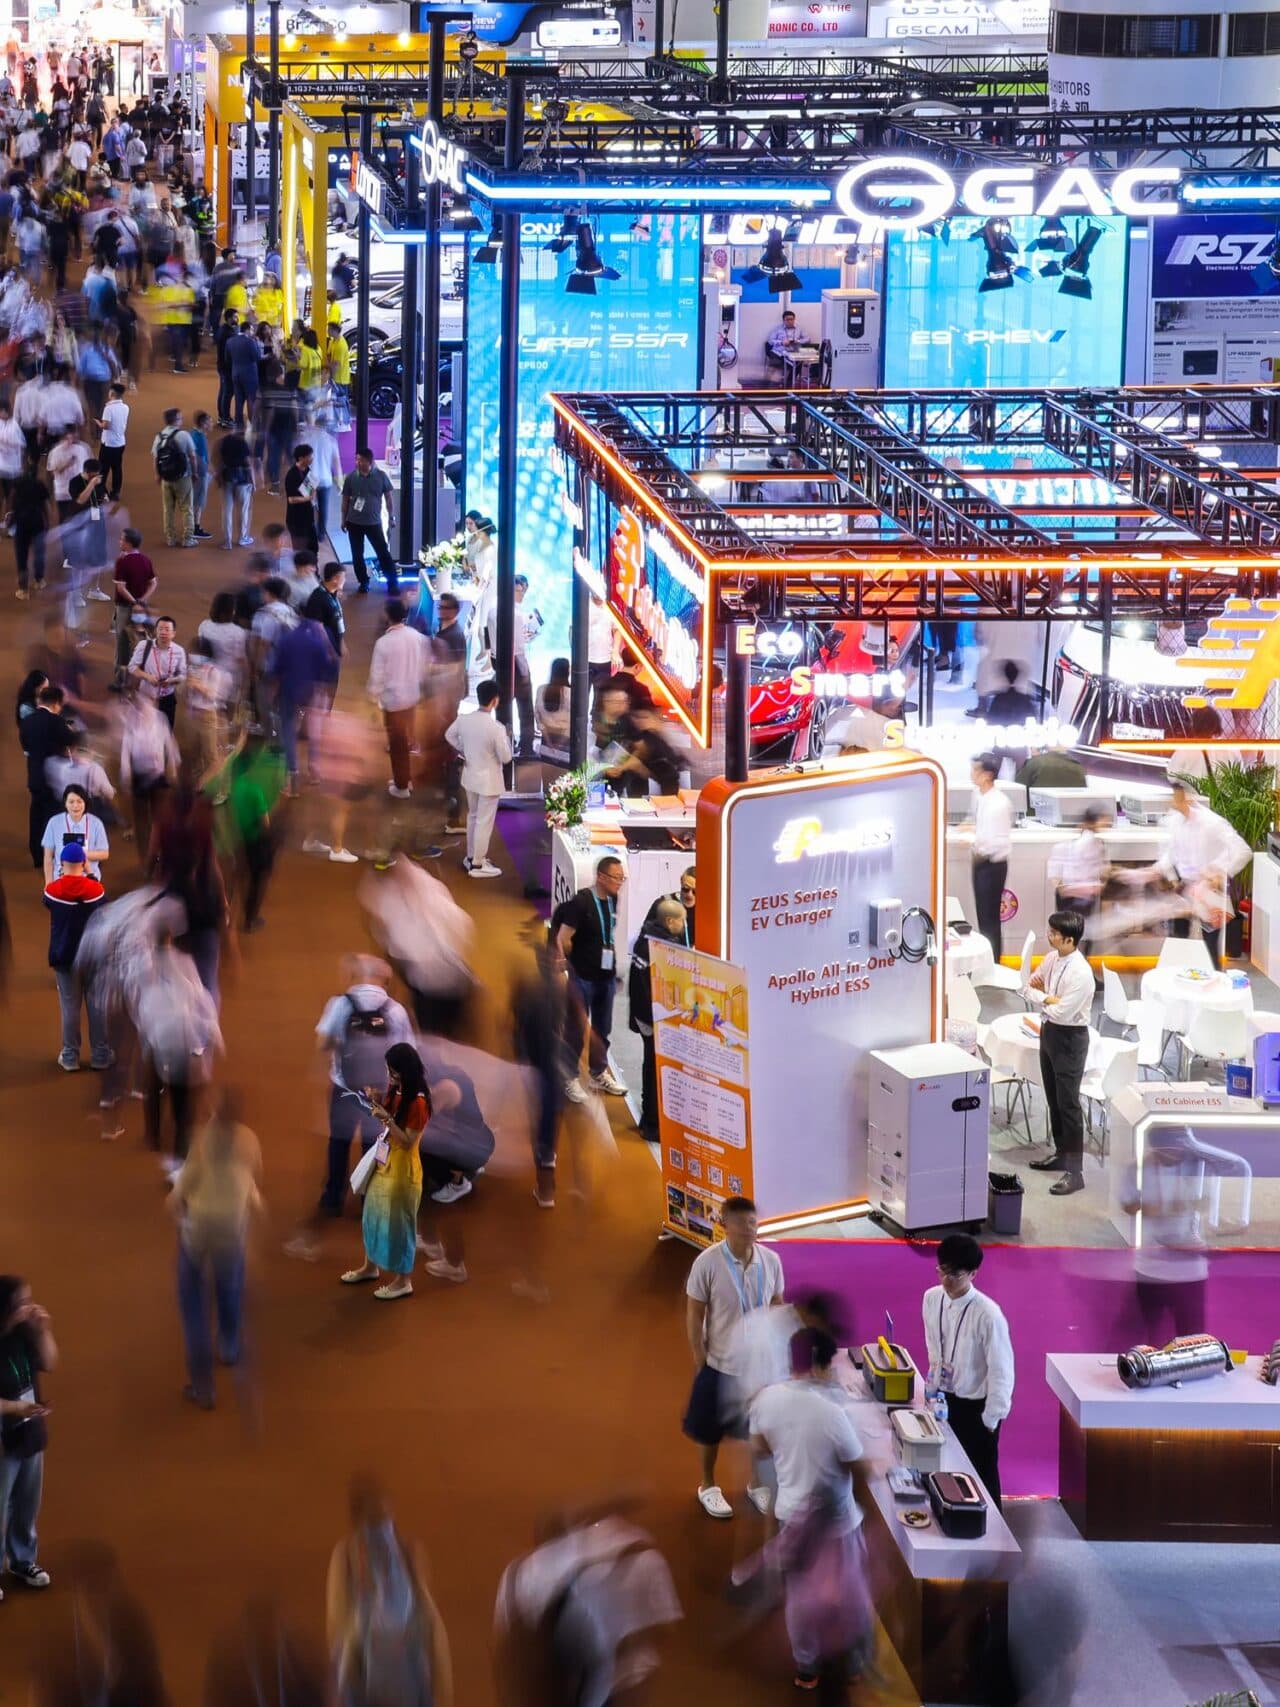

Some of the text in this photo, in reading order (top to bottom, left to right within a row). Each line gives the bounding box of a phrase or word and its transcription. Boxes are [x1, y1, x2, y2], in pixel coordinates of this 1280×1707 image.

[822, 22, 838, 31] LTD
[896, 25, 969, 35] GSCAM
[962, 168, 1181, 216] GAC
[1165, 235, 1278, 265] RSZ
[495, 332, 689, 353] yper SSR
[735, 625, 804, 656] Eco
[790, 667, 906, 698] Smart
[750, 887, 838, 913] ZEUS Series
[751, 906, 834, 932] EV Charger
[768, 955, 897, 990] Apollo All-in-One
[791, 977, 870, 1005] Hybrid ESS
